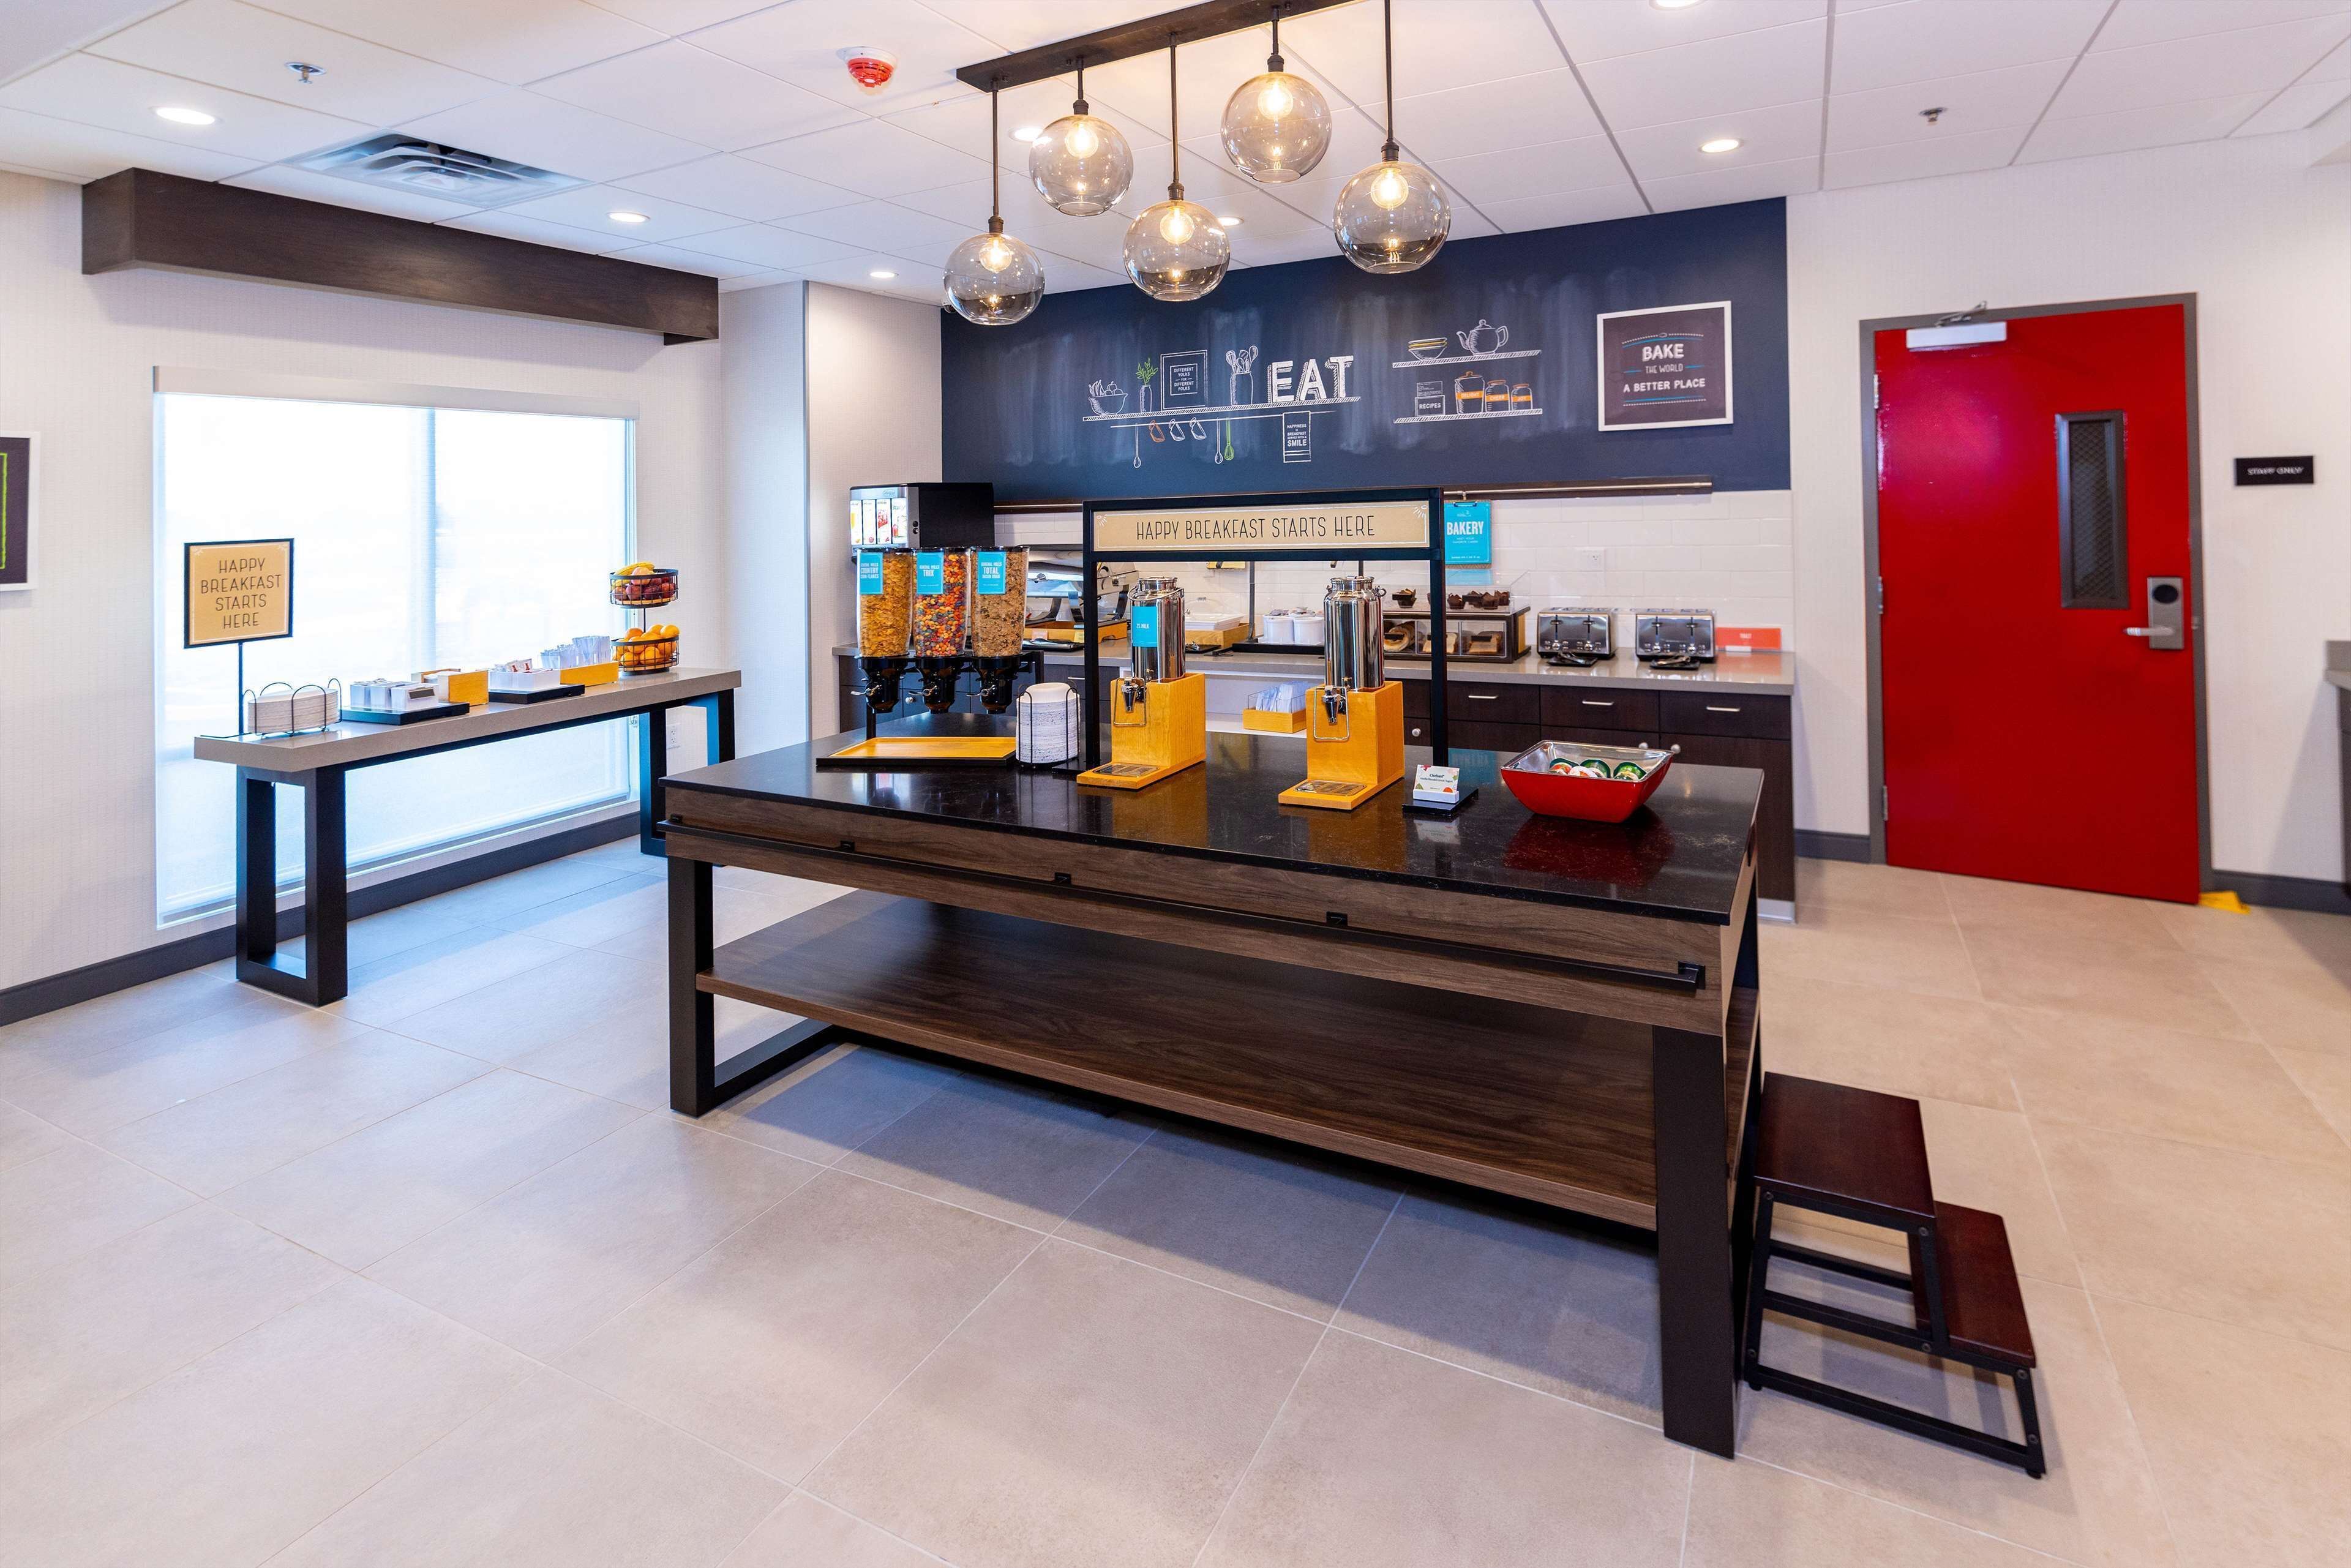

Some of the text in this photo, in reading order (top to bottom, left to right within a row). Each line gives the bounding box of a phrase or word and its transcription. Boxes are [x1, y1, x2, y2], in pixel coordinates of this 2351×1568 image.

[1642, 343, 1684, 362] BAKE
[1646, 363, 1684, 374] THE WORLD
[1268, 355, 1354, 403] EAT
[1623, 378, 1706, 393] A BETTER PLACE
[2276, 466, 2304, 475] ONLY
[1137, 516, 1375, 540] HAPPY BREAKFAST STARTS HERE
[1447, 521, 1484, 535] BAKERY
[219, 558, 265, 574] HAPPY
[201, 574, 282, 594] BREAKFAST
[216, 594, 267, 611] STARTS
[223, 612, 260, 629] HERE
